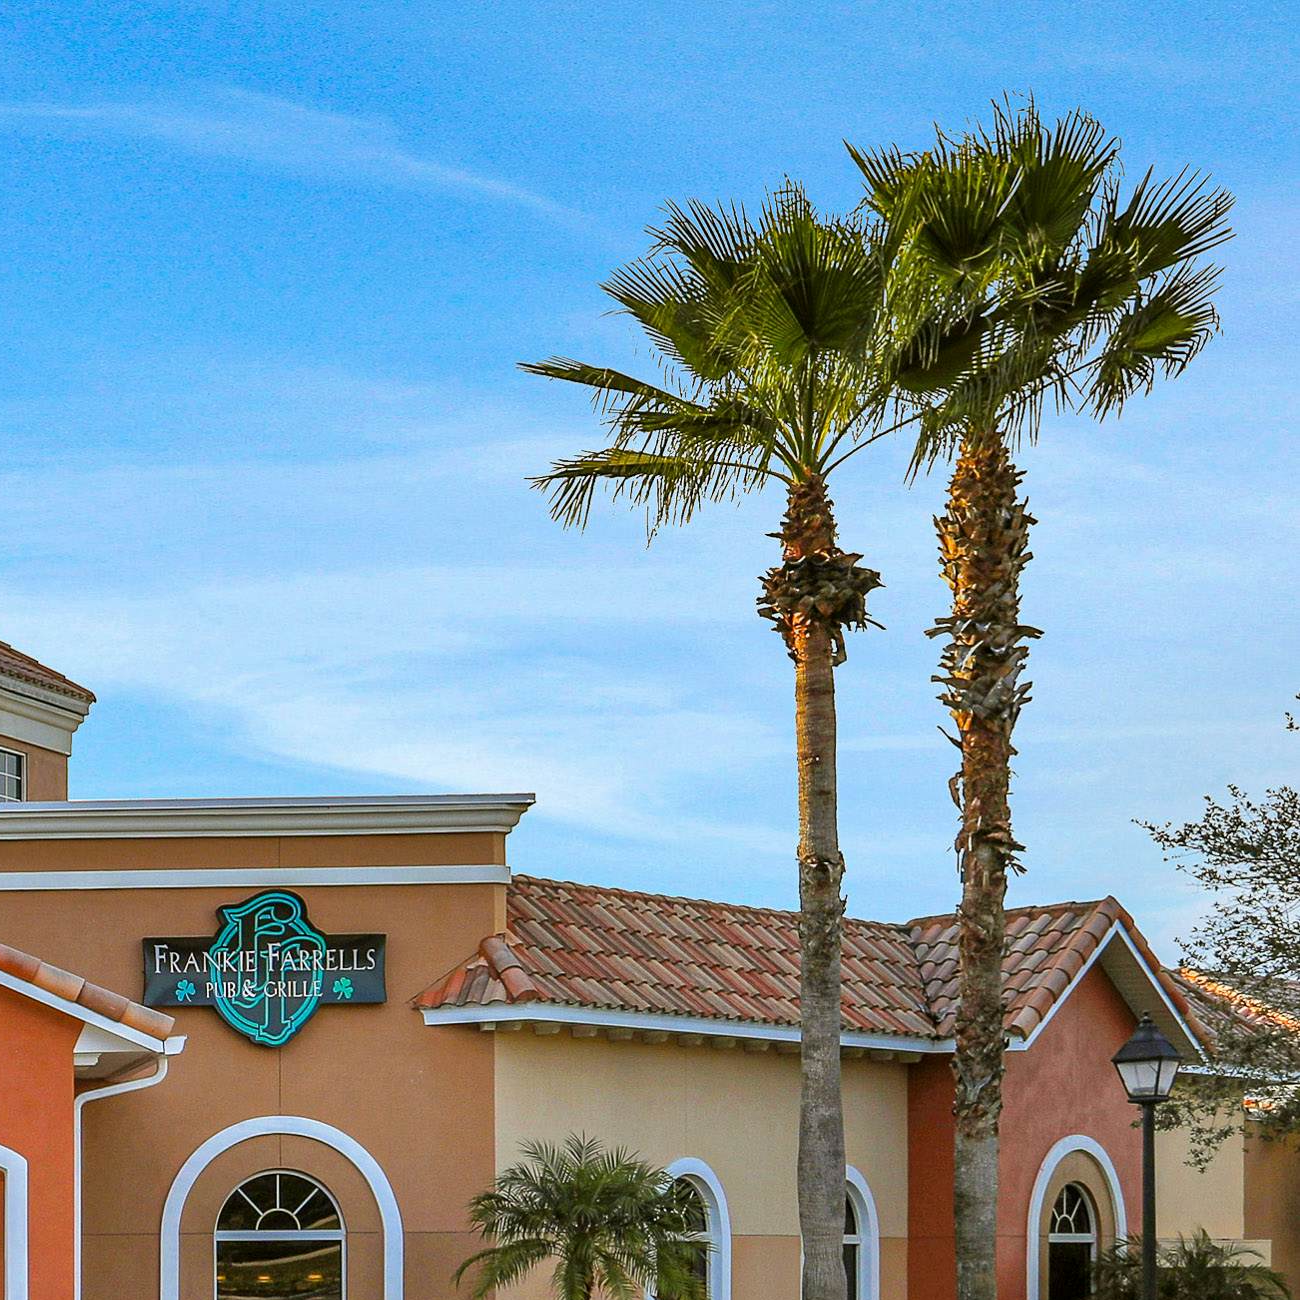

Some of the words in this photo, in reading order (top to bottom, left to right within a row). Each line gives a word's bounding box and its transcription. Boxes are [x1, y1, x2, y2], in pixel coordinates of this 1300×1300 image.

[153, 944, 258, 974] FRANKIE
[266, 942, 376, 973] FARRELLS
[205, 981, 236, 998] PUB
[241, 978, 257, 998] &
[264, 980, 323, 998] GRILLE
